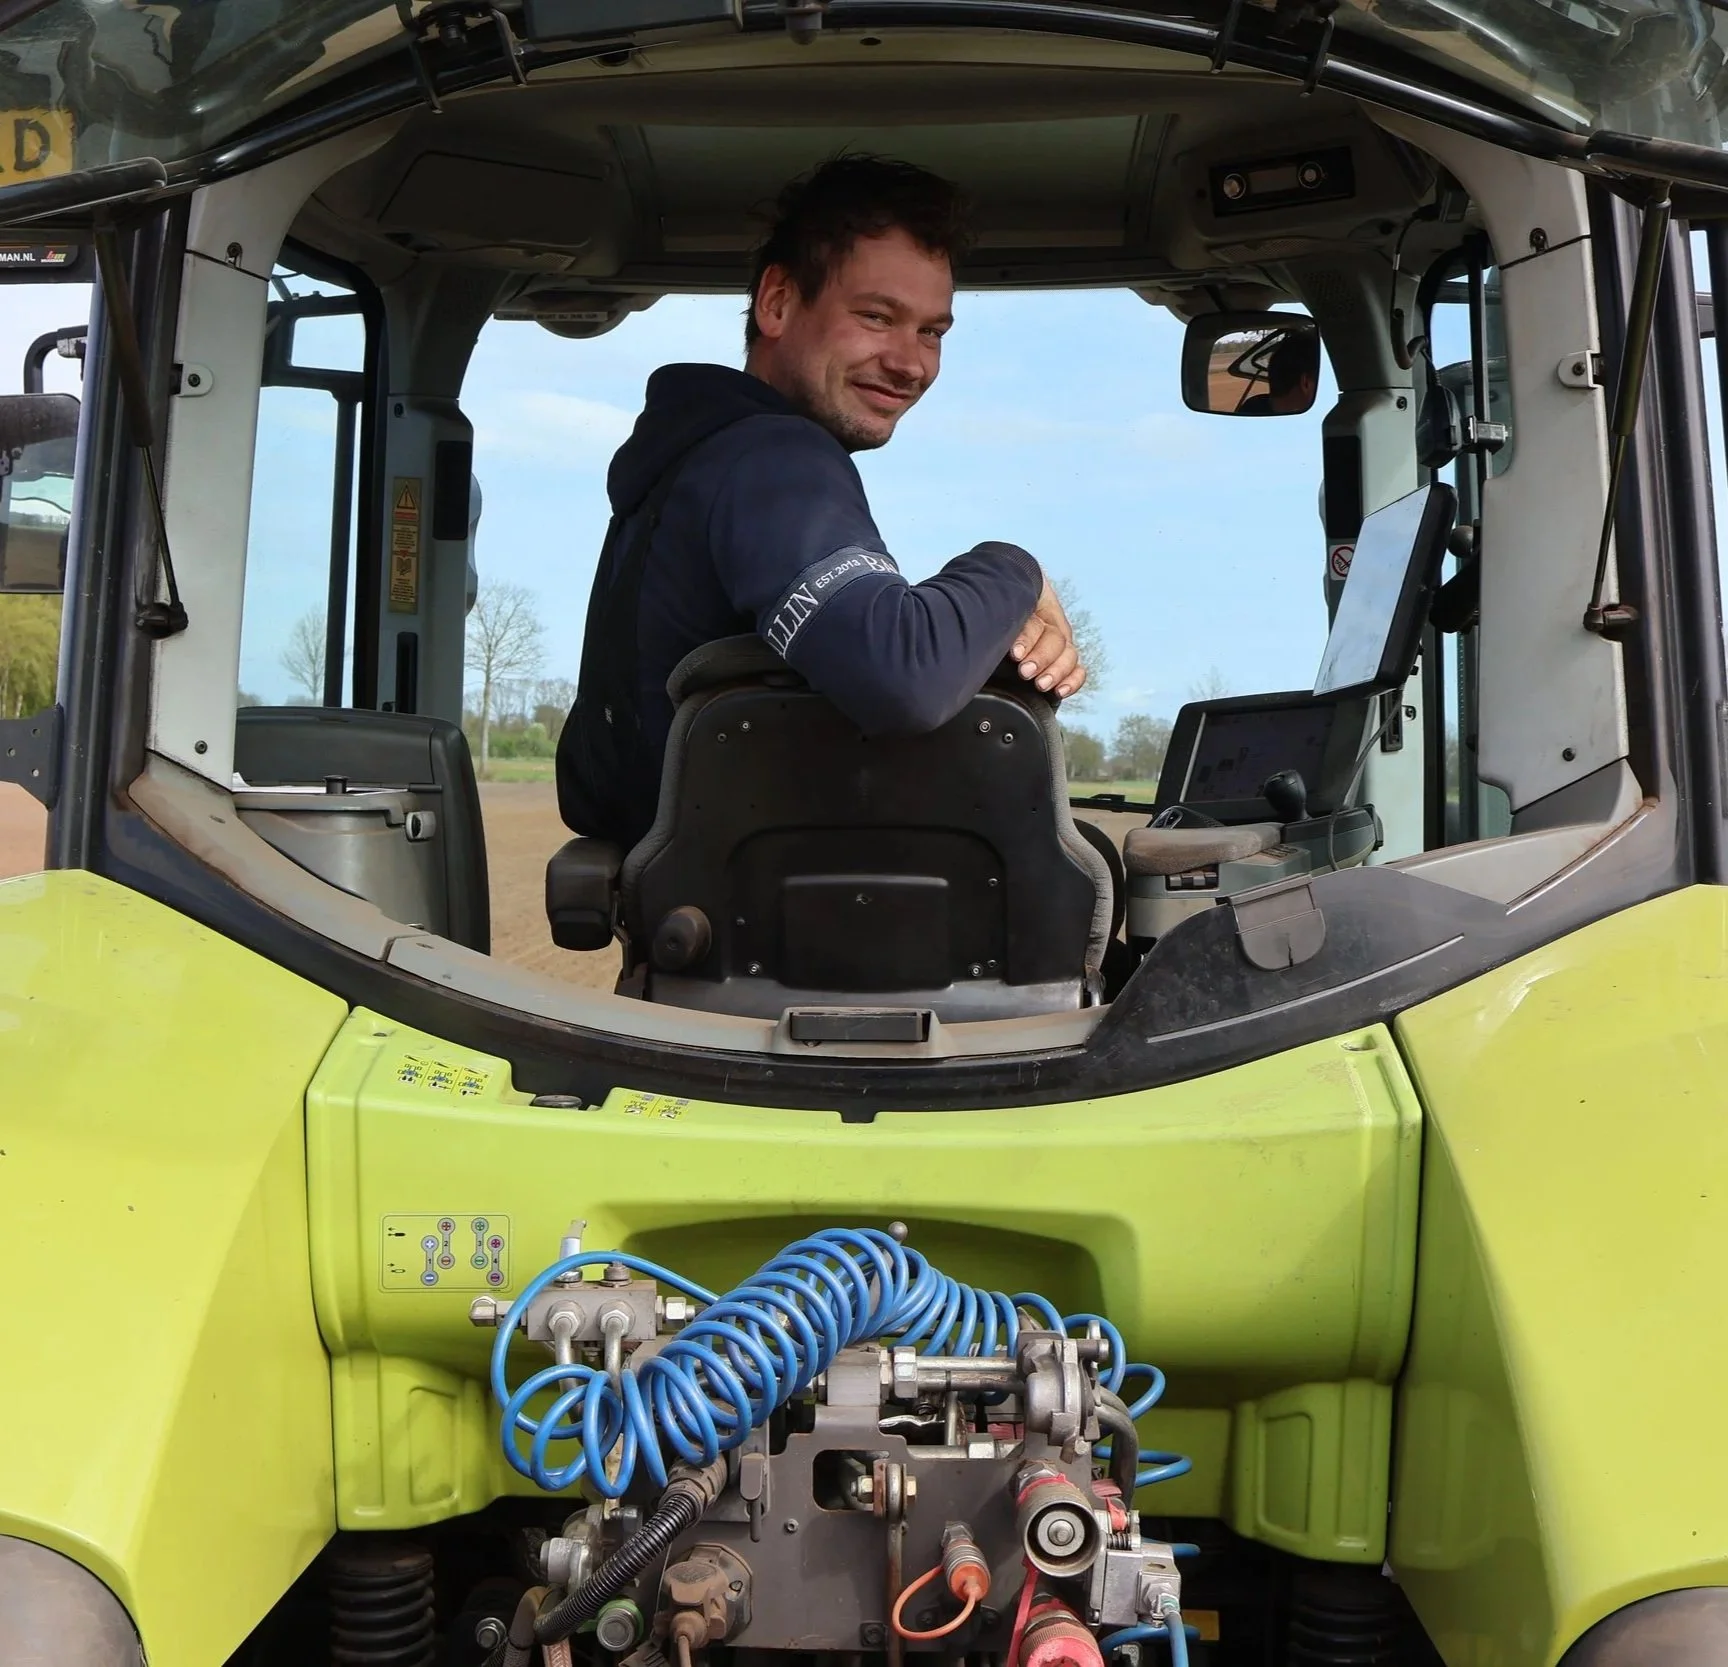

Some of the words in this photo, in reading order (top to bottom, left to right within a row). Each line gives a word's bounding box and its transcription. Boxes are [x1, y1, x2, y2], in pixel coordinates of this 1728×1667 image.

[0, 118, 50, 172] D
[766, 582, 819, 660] LLIN
[427, 1257, 432, 1265] 1
